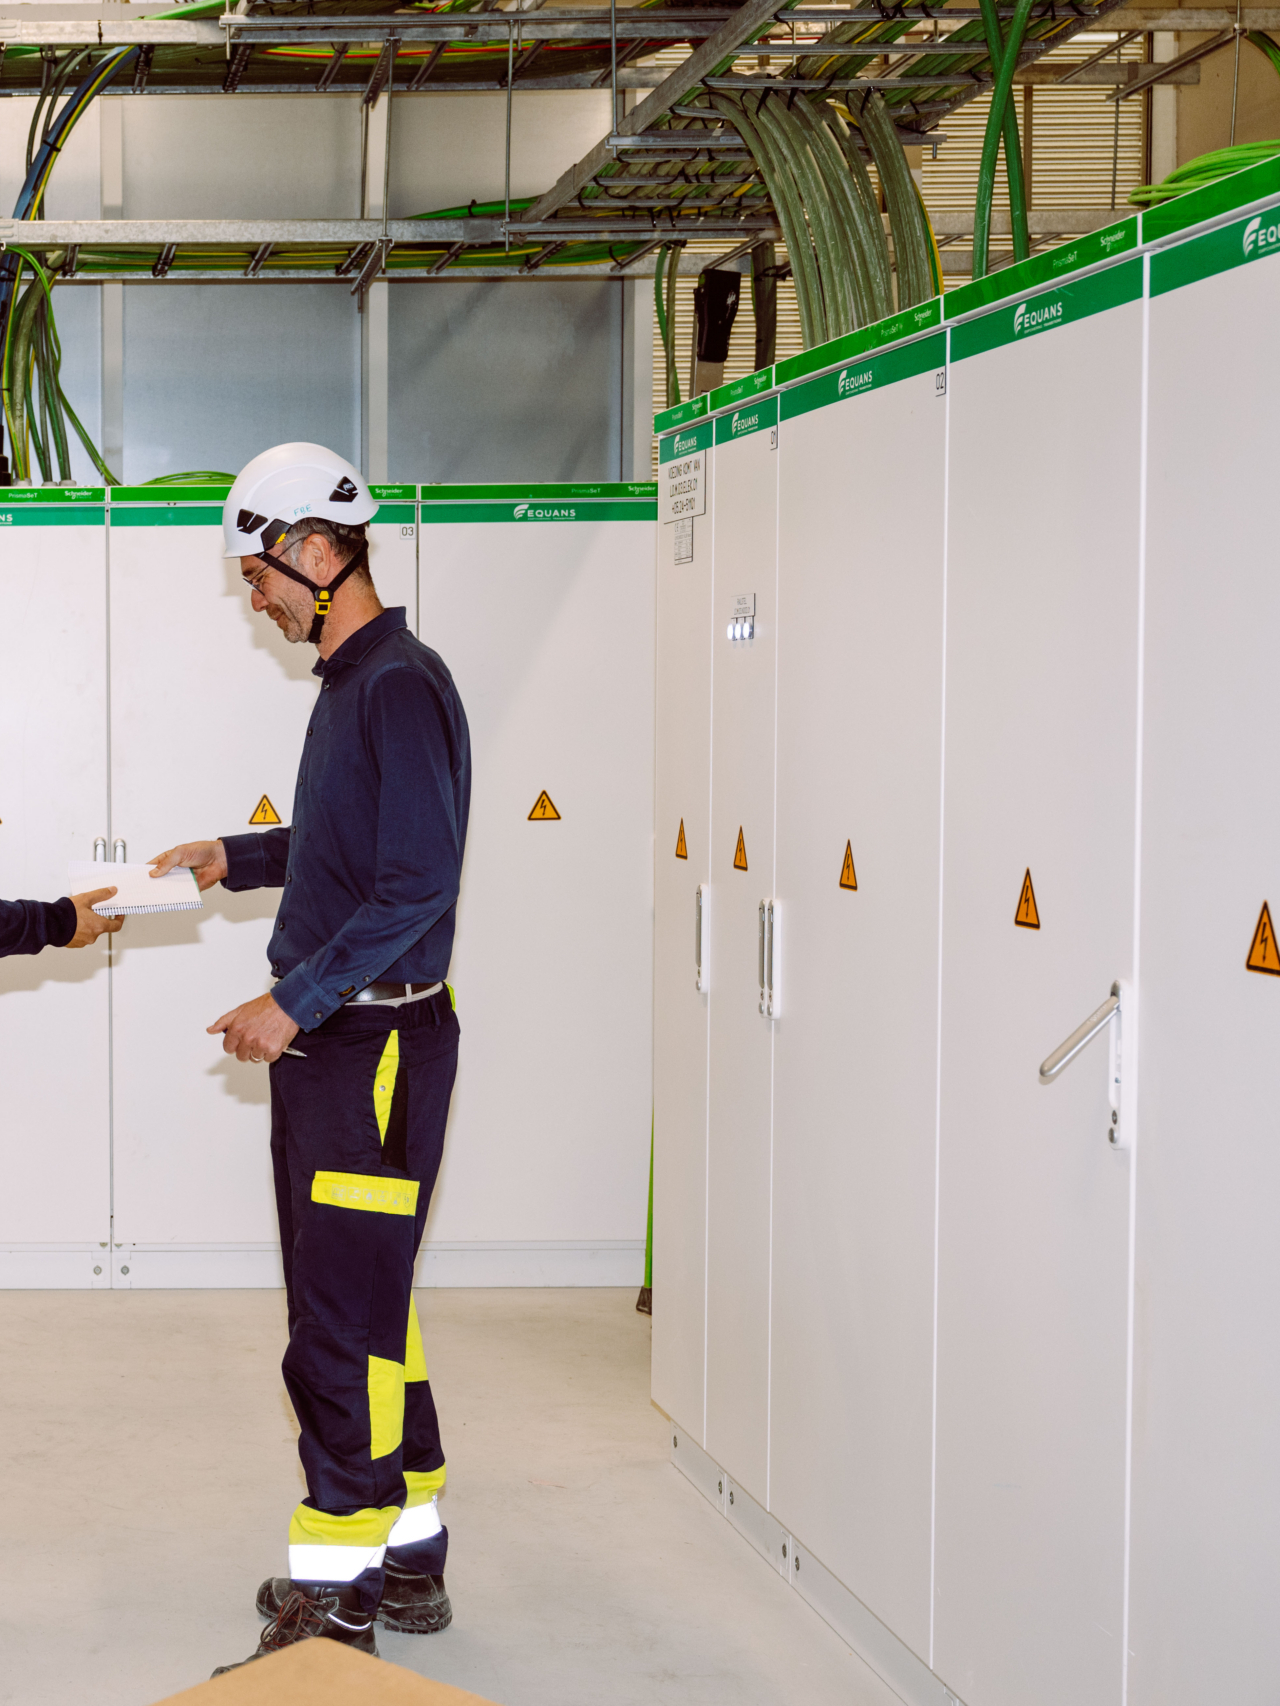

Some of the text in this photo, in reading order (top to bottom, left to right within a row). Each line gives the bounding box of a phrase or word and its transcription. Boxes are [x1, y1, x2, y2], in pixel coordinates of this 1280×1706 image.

[1100, 230, 1125, 247] Schneider
[1258, 223, 1280, 247] EQ
[1024, 302, 1063, 328] EQUANS
[845, 370, 873, 390] EQUANS
[935, 372, 944, 390] 02
[737, 414, 759, 430] EQUANS
[678, 436, 697, 451] EQUANS
[64, 490, 93, 498] Schneider
[375, 488, 403, 496] Schneider
[628, 485, 656, 493] Schneider
[527, 509, 576, 517] EQUANS
[401, 526, 414, 536] 03
